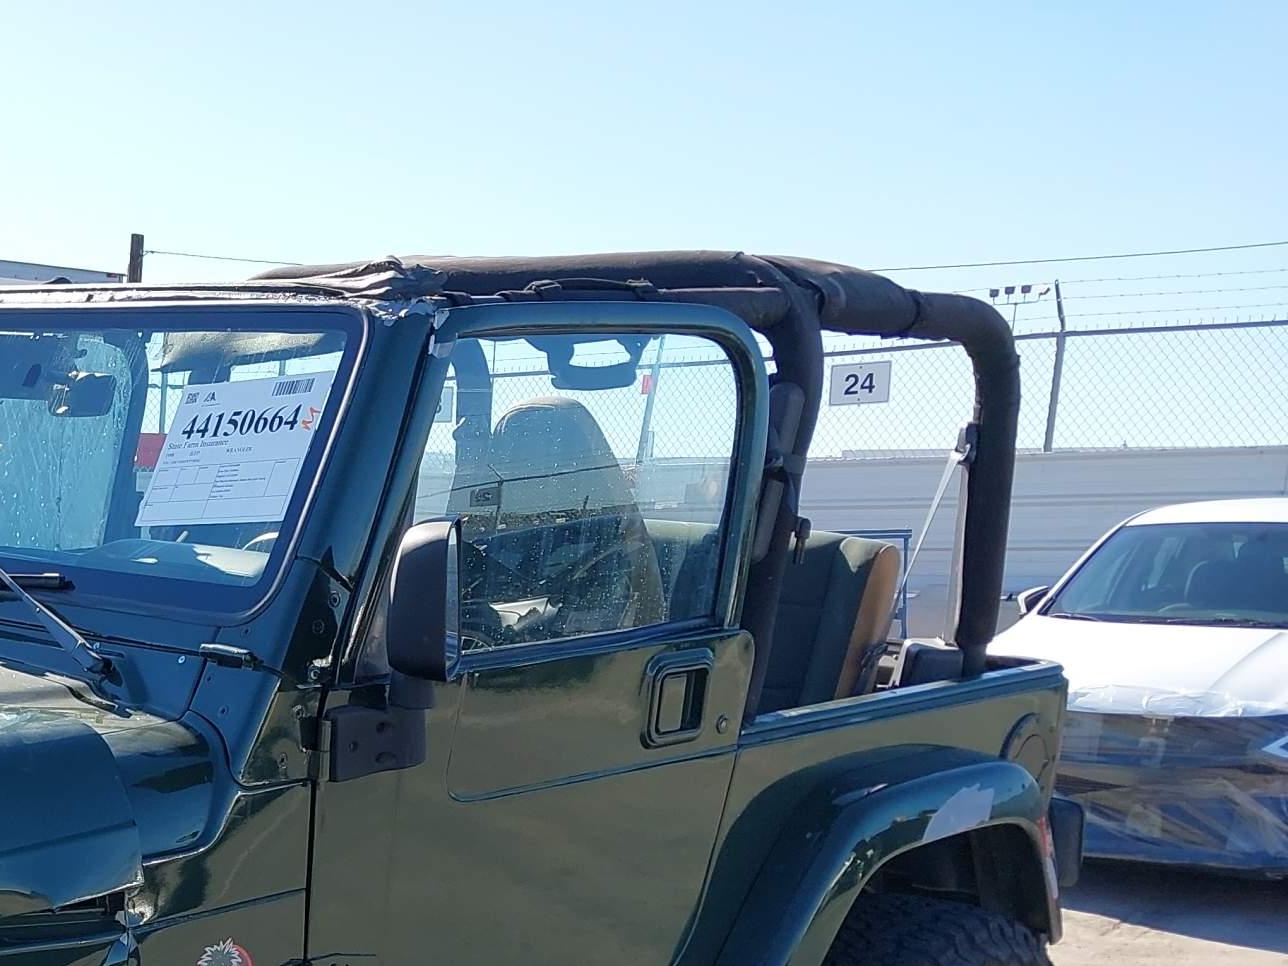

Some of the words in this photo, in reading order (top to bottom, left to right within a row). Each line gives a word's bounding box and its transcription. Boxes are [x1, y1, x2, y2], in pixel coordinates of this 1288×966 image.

[843, 372, 876, 396] 24
[181, 403, 303, 440] 44150664
[183, 441, 200, 449] Farm
[200, 439, 230, 448] Insurance
